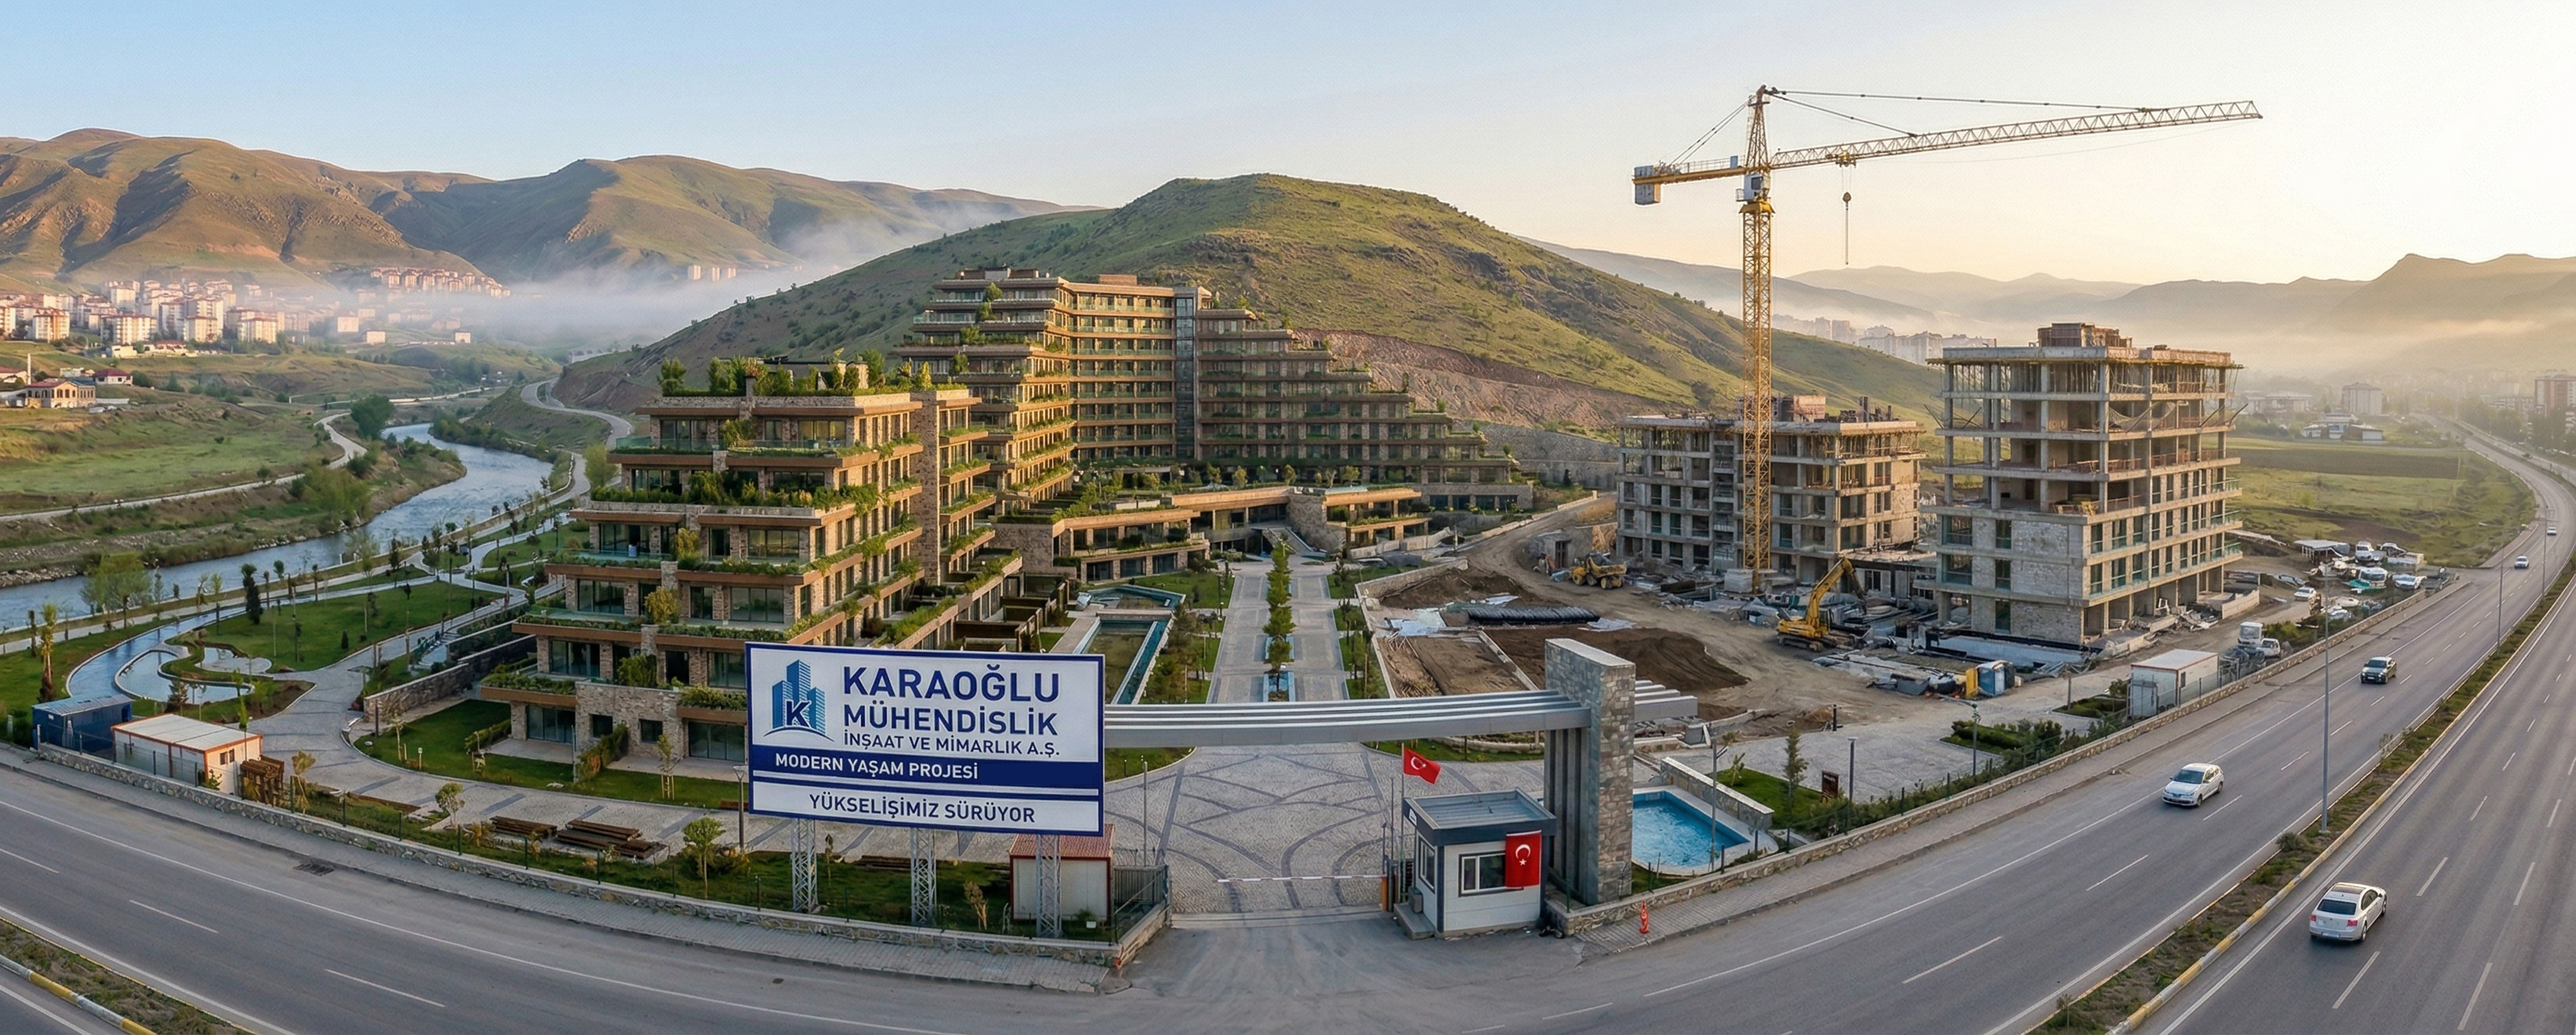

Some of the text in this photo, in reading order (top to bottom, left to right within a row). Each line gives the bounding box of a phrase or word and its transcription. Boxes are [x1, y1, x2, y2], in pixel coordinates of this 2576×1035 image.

[844, 663, 1059, 703] KARAOĞLU
[786, 700, 811, 728] K
[844, 700, 1058, 736] MÜHENDİSLİK
[844, 732, 1060, 758] İNŞAAT VE MİMARLIK A.Ş.
[775, 753, 979, 779] MODERN YAŞAM PROJESİ
[809, 790, 1035, 823] YÜKSELİŞİMİZ SÜRÜYOR
